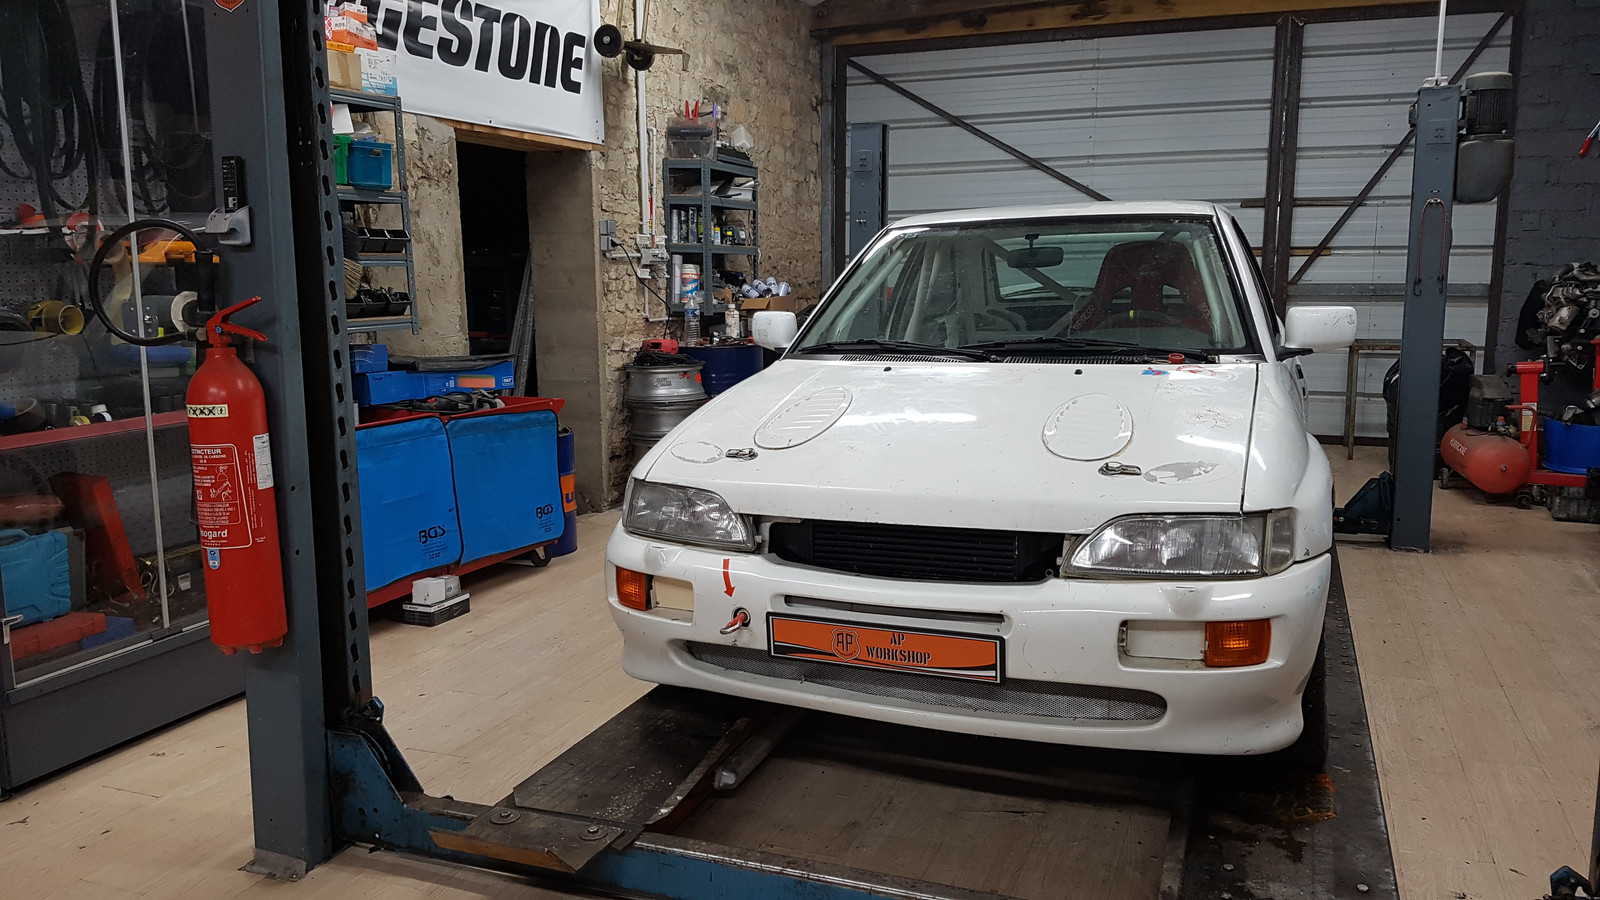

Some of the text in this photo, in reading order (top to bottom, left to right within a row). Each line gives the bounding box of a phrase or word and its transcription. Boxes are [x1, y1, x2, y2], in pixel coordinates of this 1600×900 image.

[535, 503, 554, 520] BGS
[419, 525, 446, 544] BGS
[836, 633, 853, 651] AP
[890, 632, 906, 646] AP
[866, 646, 931, 664] WORKSHOP
